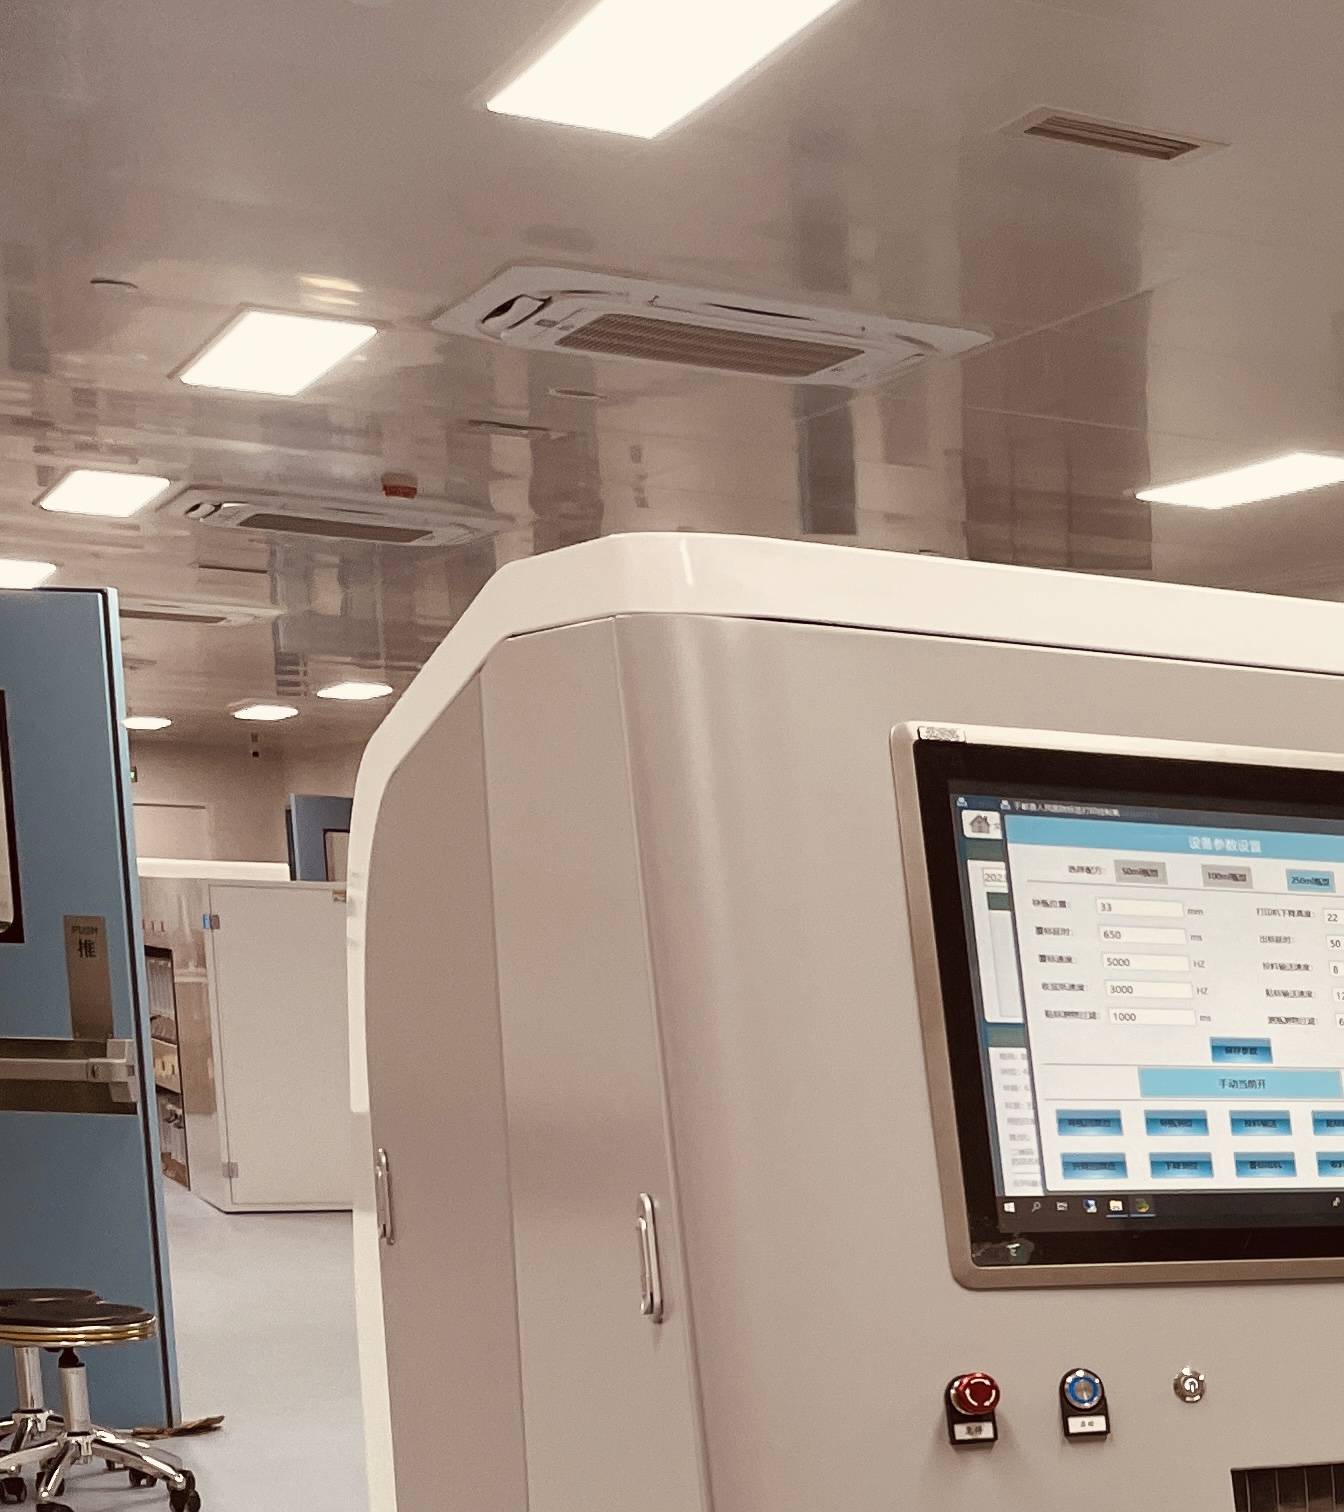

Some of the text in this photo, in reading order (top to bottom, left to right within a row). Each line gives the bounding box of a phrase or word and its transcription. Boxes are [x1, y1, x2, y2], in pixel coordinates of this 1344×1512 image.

[1100, 903, 1112, 912] 33
[1327, 913, 1338, 922] 22
[1103, 930, 1122, 940] 650
[78, 939, 97, 958] 推
[1330, 939, 1341, 948] 50
[1106, 957, 1130, 967] 5000
[1110, 984, 1133, 994] 3000
[1113, 1012, 1136, 1022] 1000
